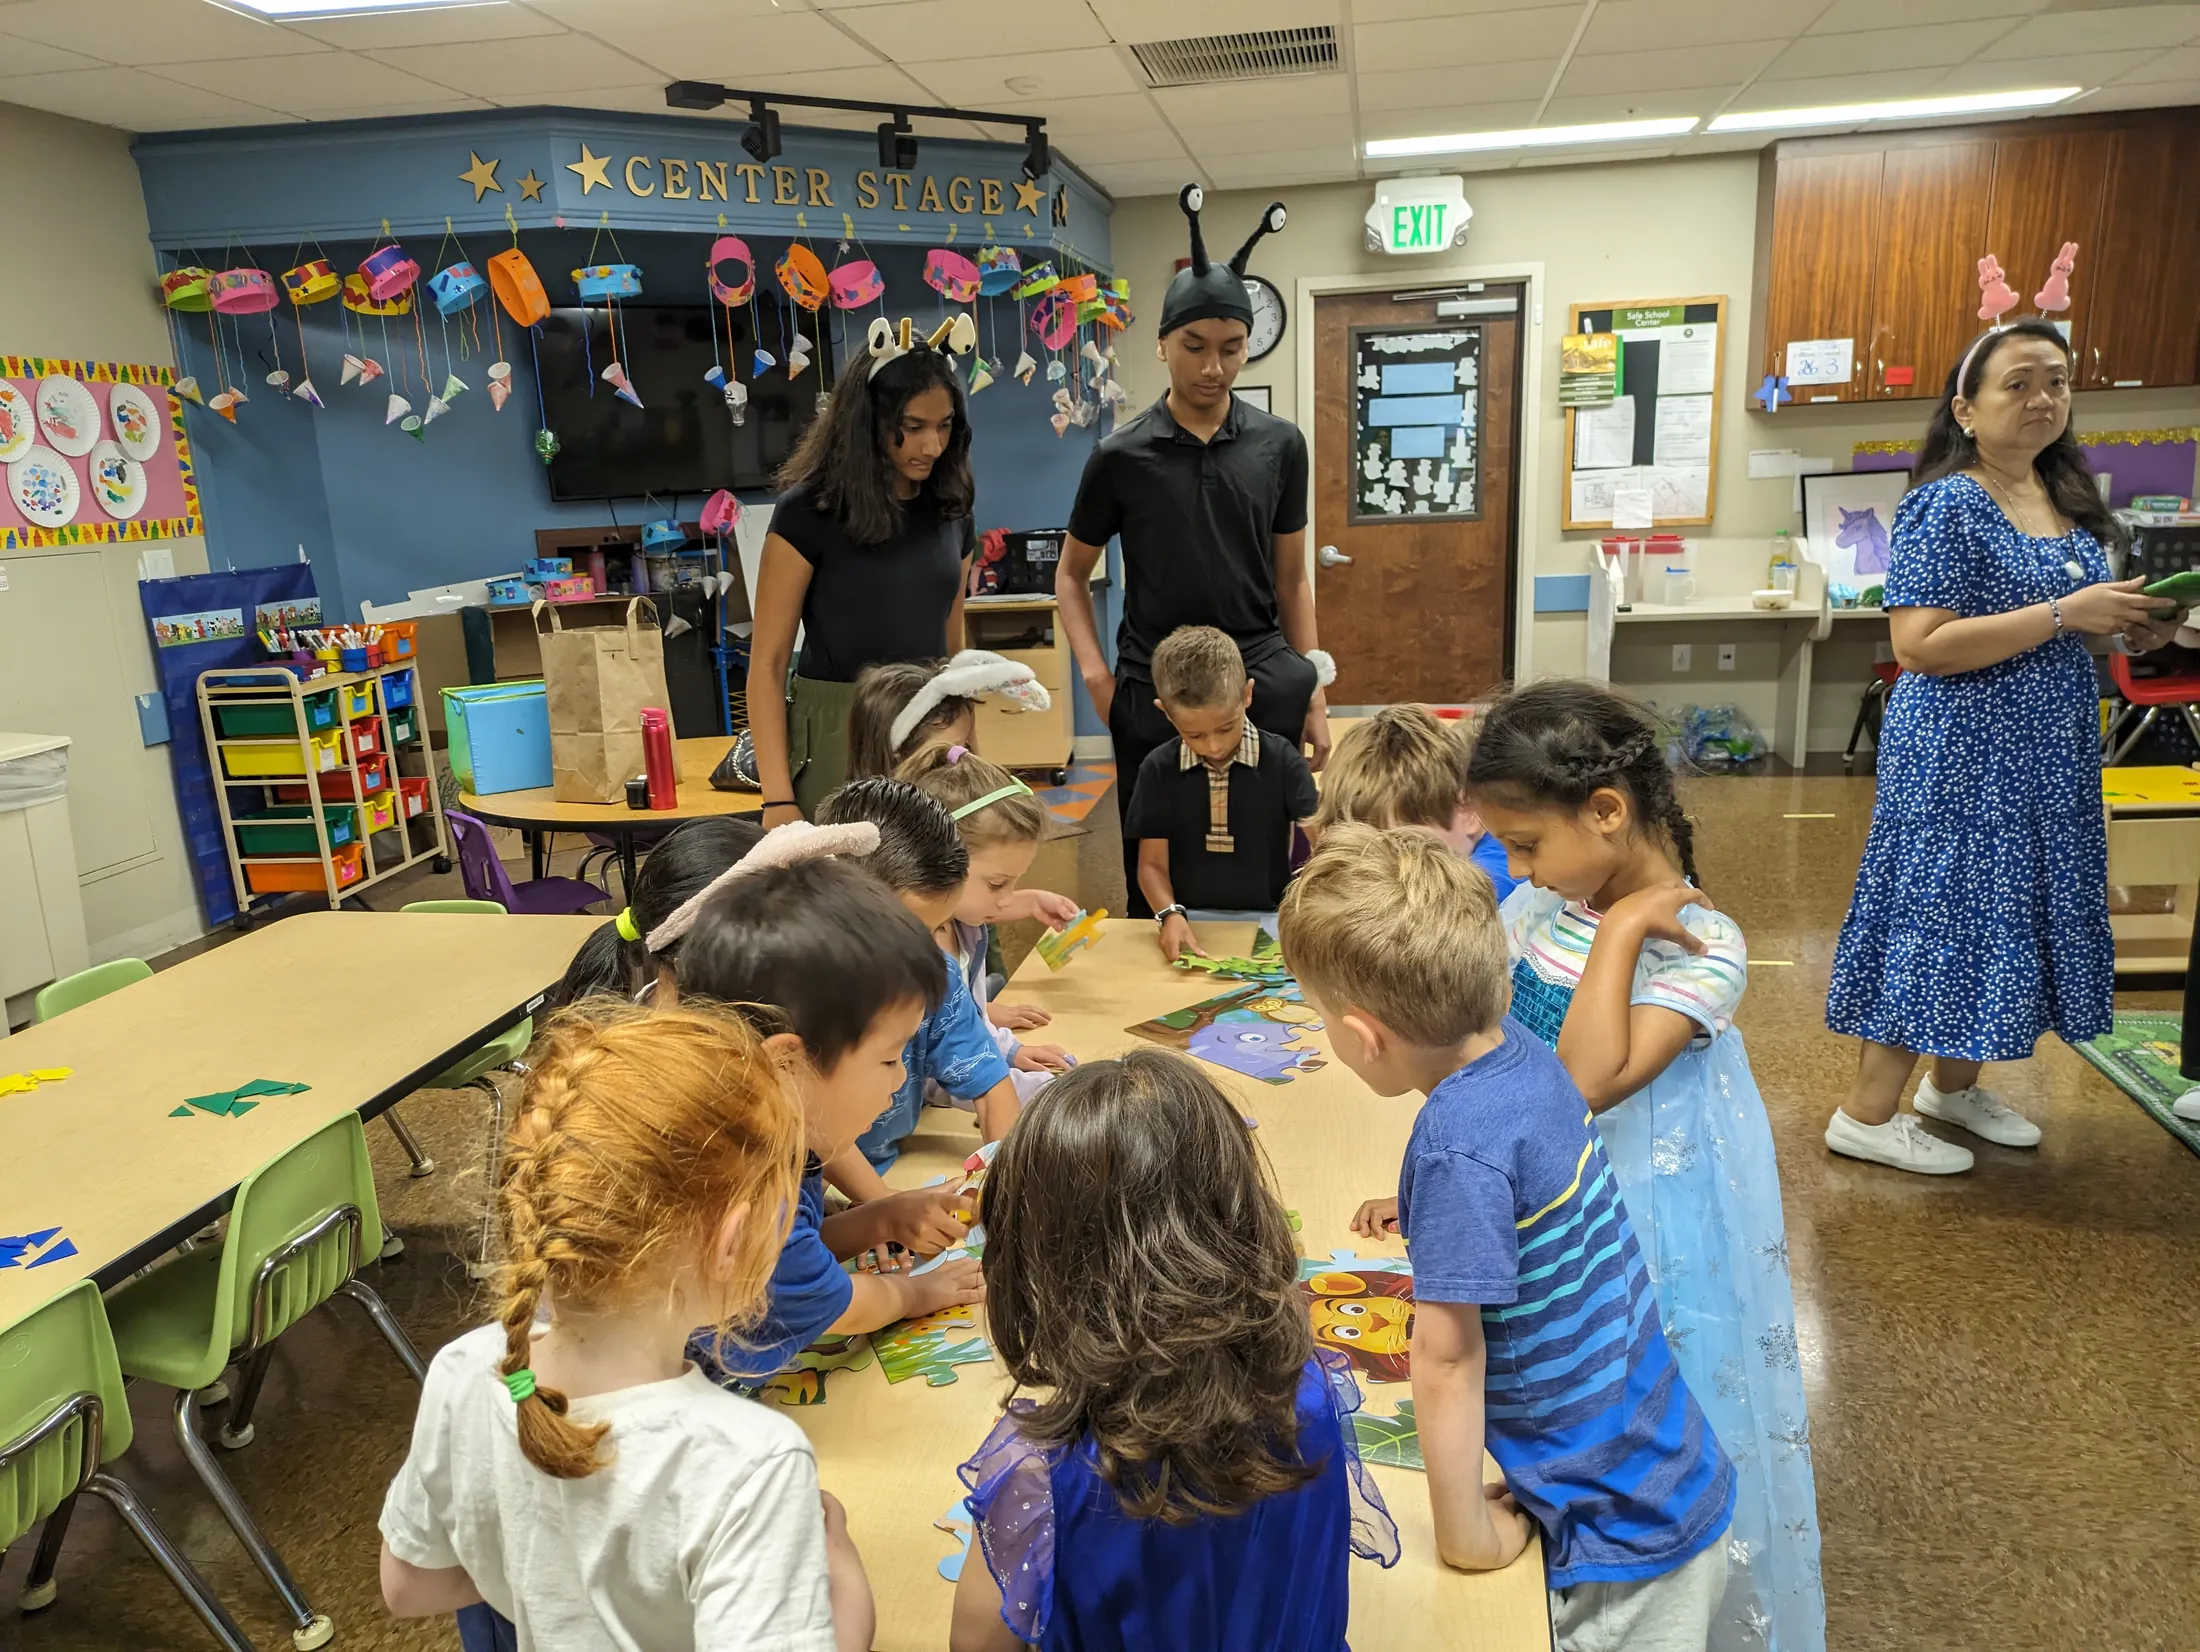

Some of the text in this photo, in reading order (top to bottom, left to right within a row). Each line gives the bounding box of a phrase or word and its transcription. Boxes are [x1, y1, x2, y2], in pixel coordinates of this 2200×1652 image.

[625, 156, 1005, 215] CENTER STAGE
[1393, 204, 1447, 247] EXIT
[1266, 298, 1273, 308] 2
[1271, 313, 1278, 322] 3
[1626, 309, 1670, 321] Safe School
[1634, 319, 1661, 328] Center
[1257, 338, 1264, 347] 5
[1825, 357, 1839, 376] 3
